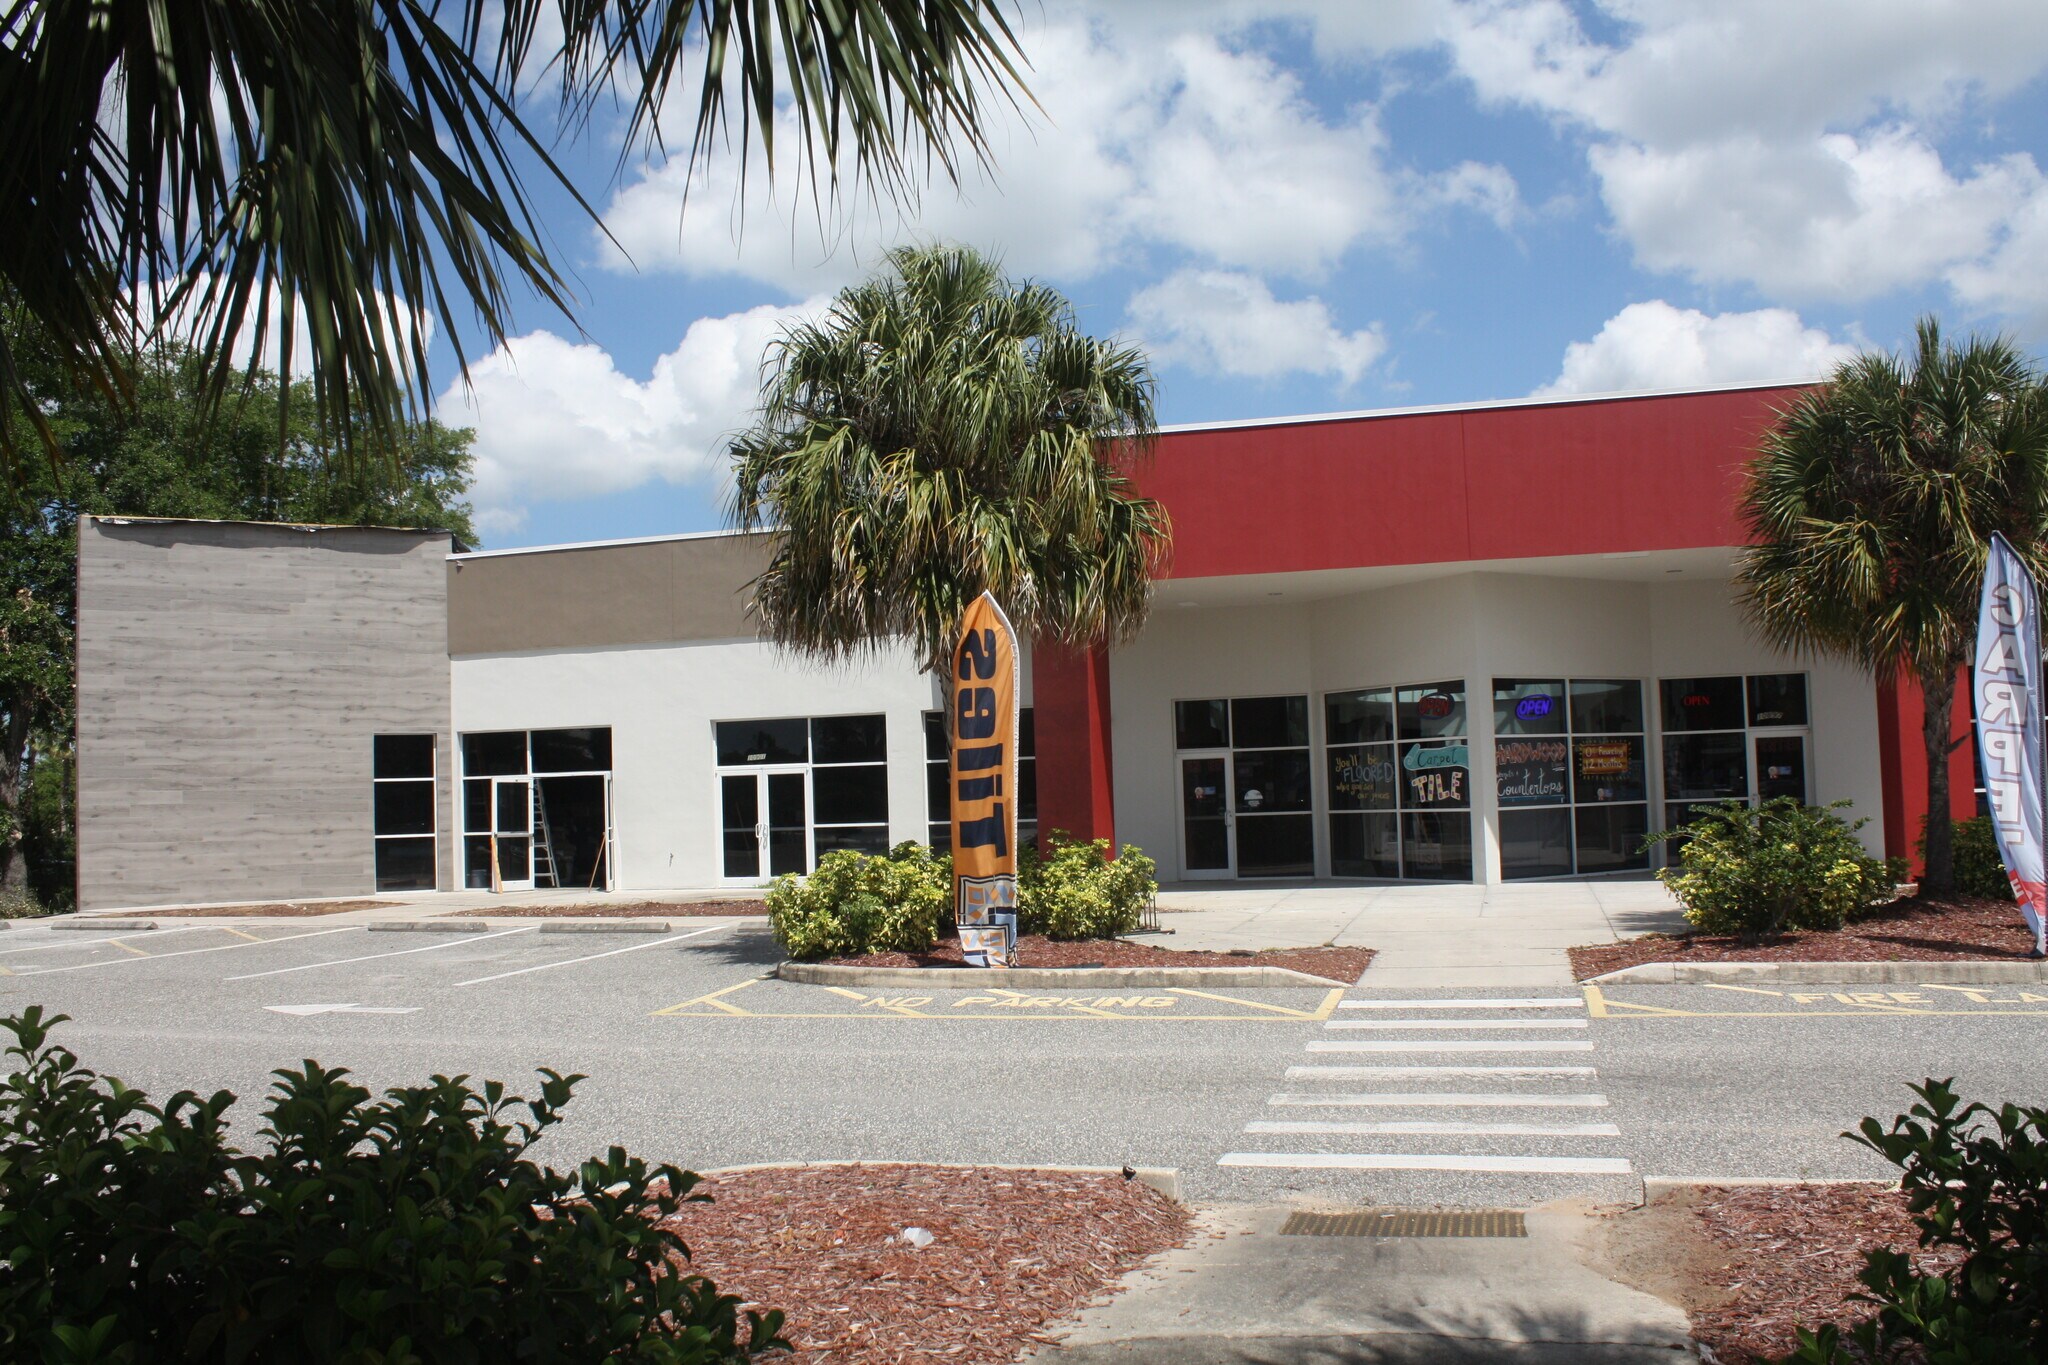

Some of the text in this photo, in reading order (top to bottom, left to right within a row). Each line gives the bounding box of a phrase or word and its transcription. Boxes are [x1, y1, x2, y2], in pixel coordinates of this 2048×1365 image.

[1419, 697, 1449, 716] OPEN
[1519, 700, 1550, 715] OPEN
[1683, 695, 1710, 706] OPEN
[1417, 748, 1457, 768] Carpet
[1585, 758, 1595, 769] 12
[1343, 760, 1394, 783] FLOORED
[1411, 772, 1462, 803] TILE
[1496, 767, 1563, 796] Countertops
[861, 996, 1179, 1008] NO PARKING
[1788, 992, 1935, 1004] FIRE
